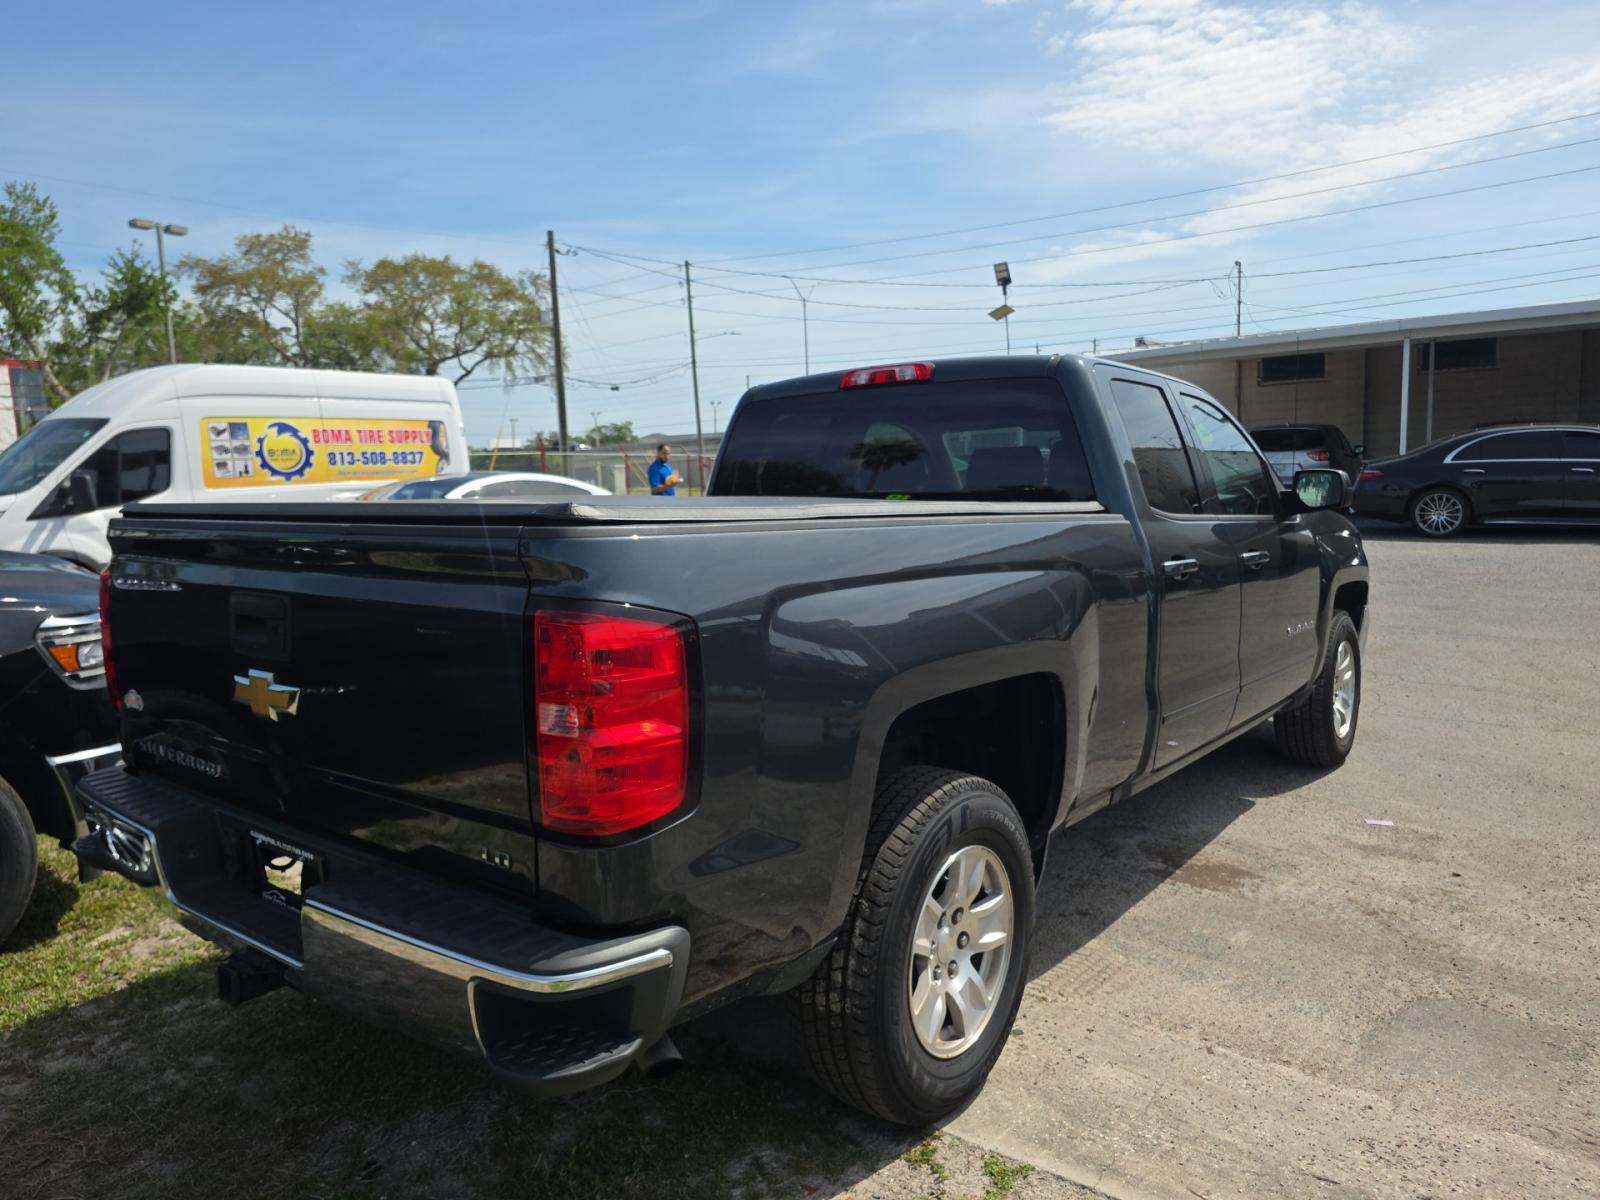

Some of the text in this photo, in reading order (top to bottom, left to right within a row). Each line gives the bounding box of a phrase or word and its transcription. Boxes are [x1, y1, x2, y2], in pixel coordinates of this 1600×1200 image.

[312, 429, 432, 444] BOMA TIRE SUPPLY
[328, 451, 424, 466] 813-508-8837
